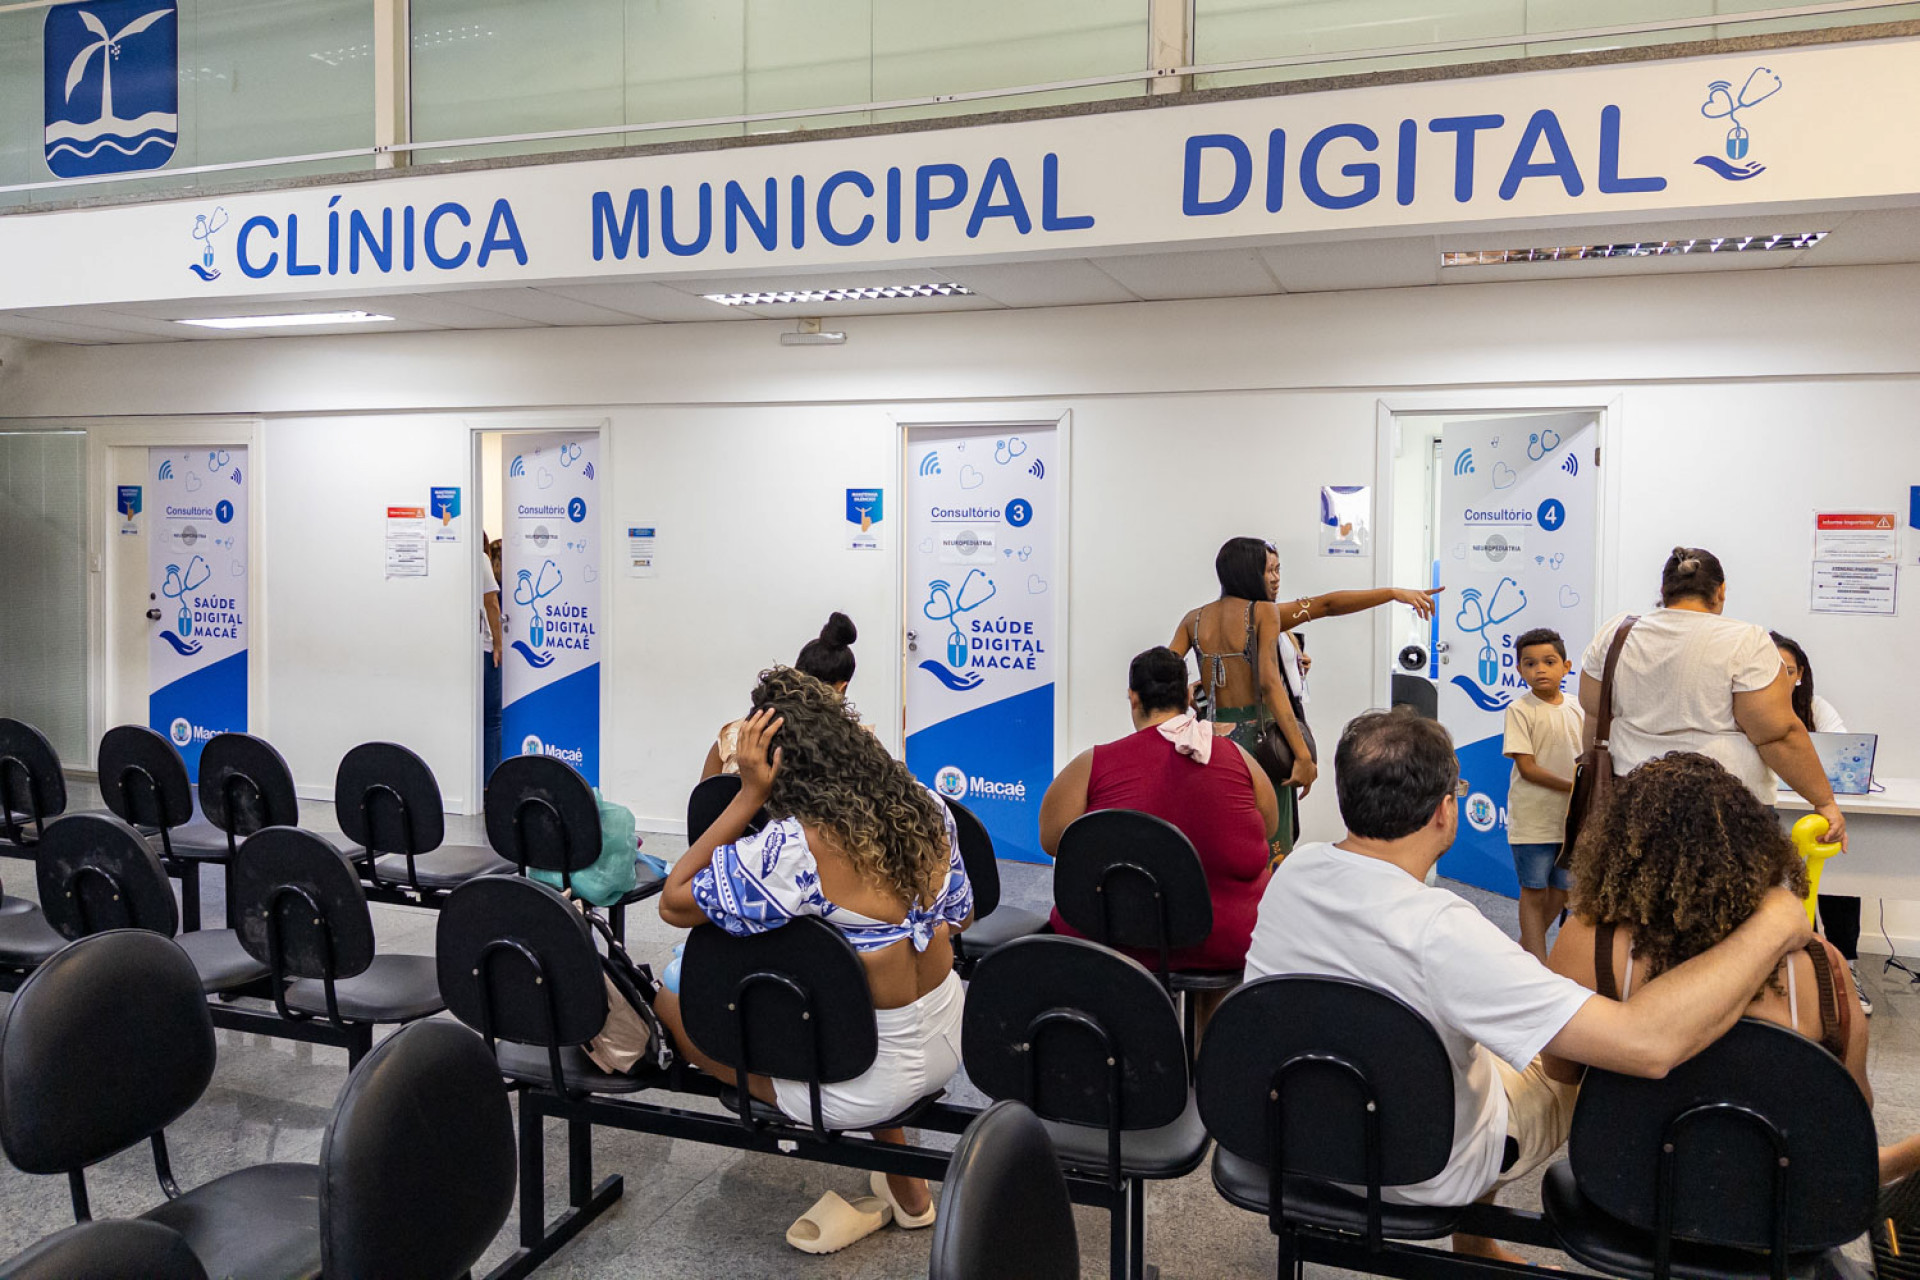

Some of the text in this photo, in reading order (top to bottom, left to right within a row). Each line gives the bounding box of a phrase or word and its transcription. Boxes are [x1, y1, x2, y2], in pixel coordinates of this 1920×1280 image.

[236, 104, 1668, 280] CLÍNICA MUNICIPAL DIGITAL
[166, 505, 228, 519] Consultório 1
[518, 503, 582, 517] Consultório 2
[931, 504, 1025, 522] Consultório 3
[1464, 505, 1557, 525] Consultório 4
[194, 594, 236, 610] SAÚDE
[546, 602, 588, 618] SAÚDE
[194, 612, 243, 625] DIGITAL
[971, 616, 1034, 634] SAÚDE
[194, 625, 238, 639] MACAÉ
[546, 621, 595, 635] DIGITAL
[546, 635, 590, 650] MACAÉ
[971, 637, 1045, 653] DIGITAL
[971, 653, 1037, 670] MACAÉ
[193, 726, 229, 740] Mac
[545, 744, 583, 762] Macaé
[970, 776, 1026, 797] Macaé
